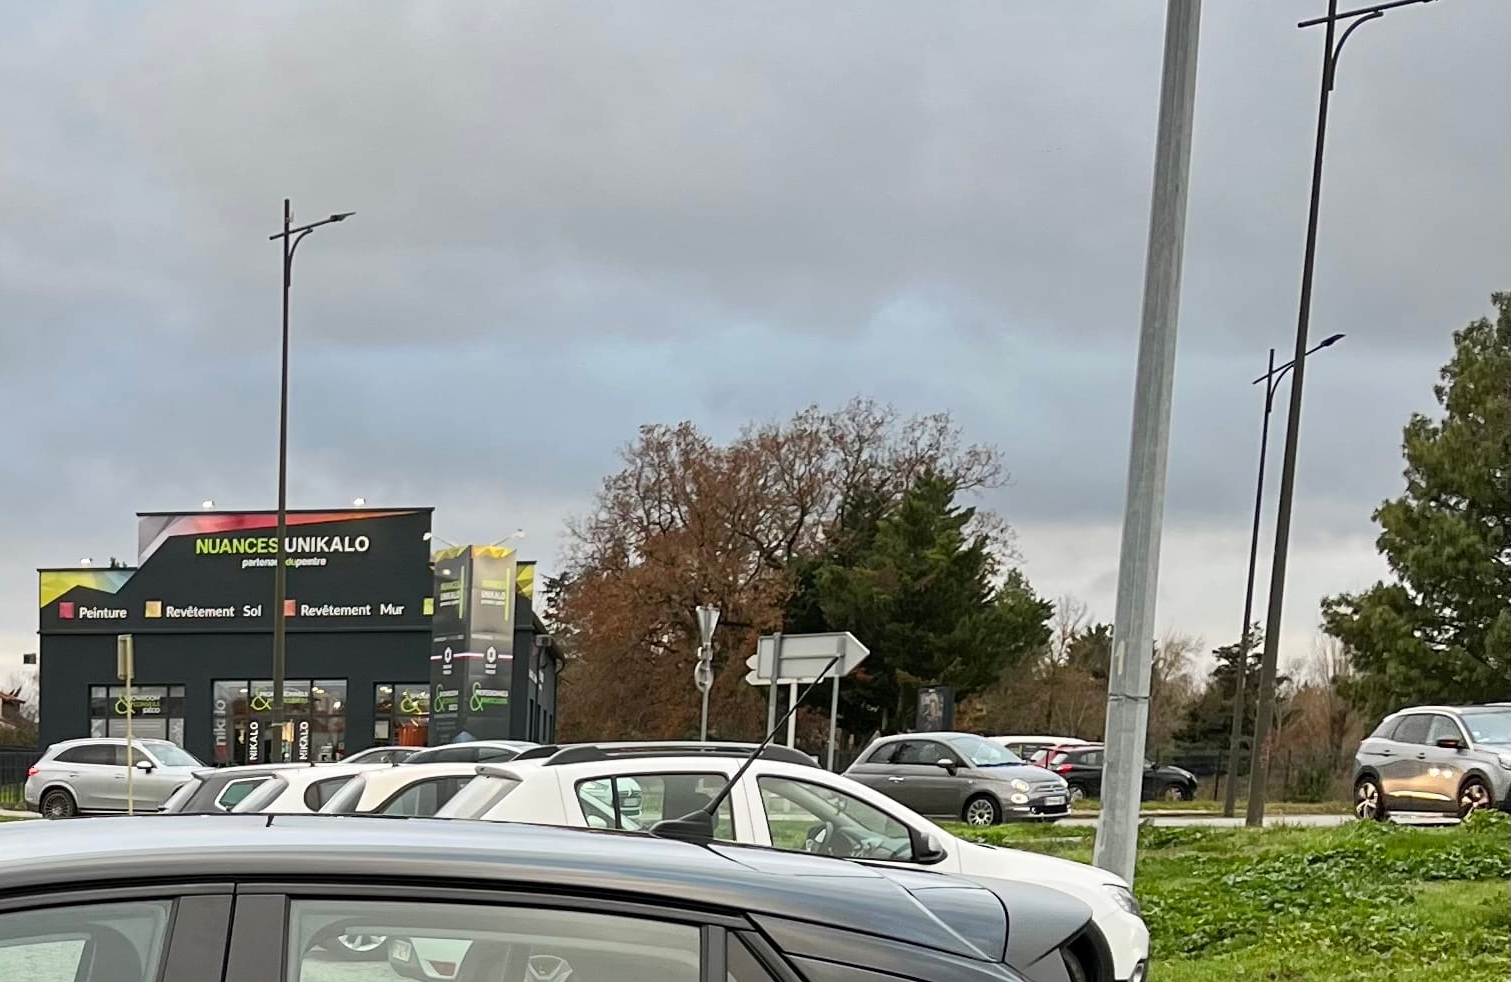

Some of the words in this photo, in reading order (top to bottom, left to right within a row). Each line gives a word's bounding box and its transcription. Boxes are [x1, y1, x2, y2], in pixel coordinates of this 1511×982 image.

[196, 538, 279, 554] NUANCES
[284, 535, 370, 553] UNIKALO
[79, 606, 128, 619] Peinture
[166, 605, 235, 618] Revêtement
[243, 604, 262, 617] Sol
[301, 604, 371, 617] Revêtement
[380, 603, 404, 616] Mur
